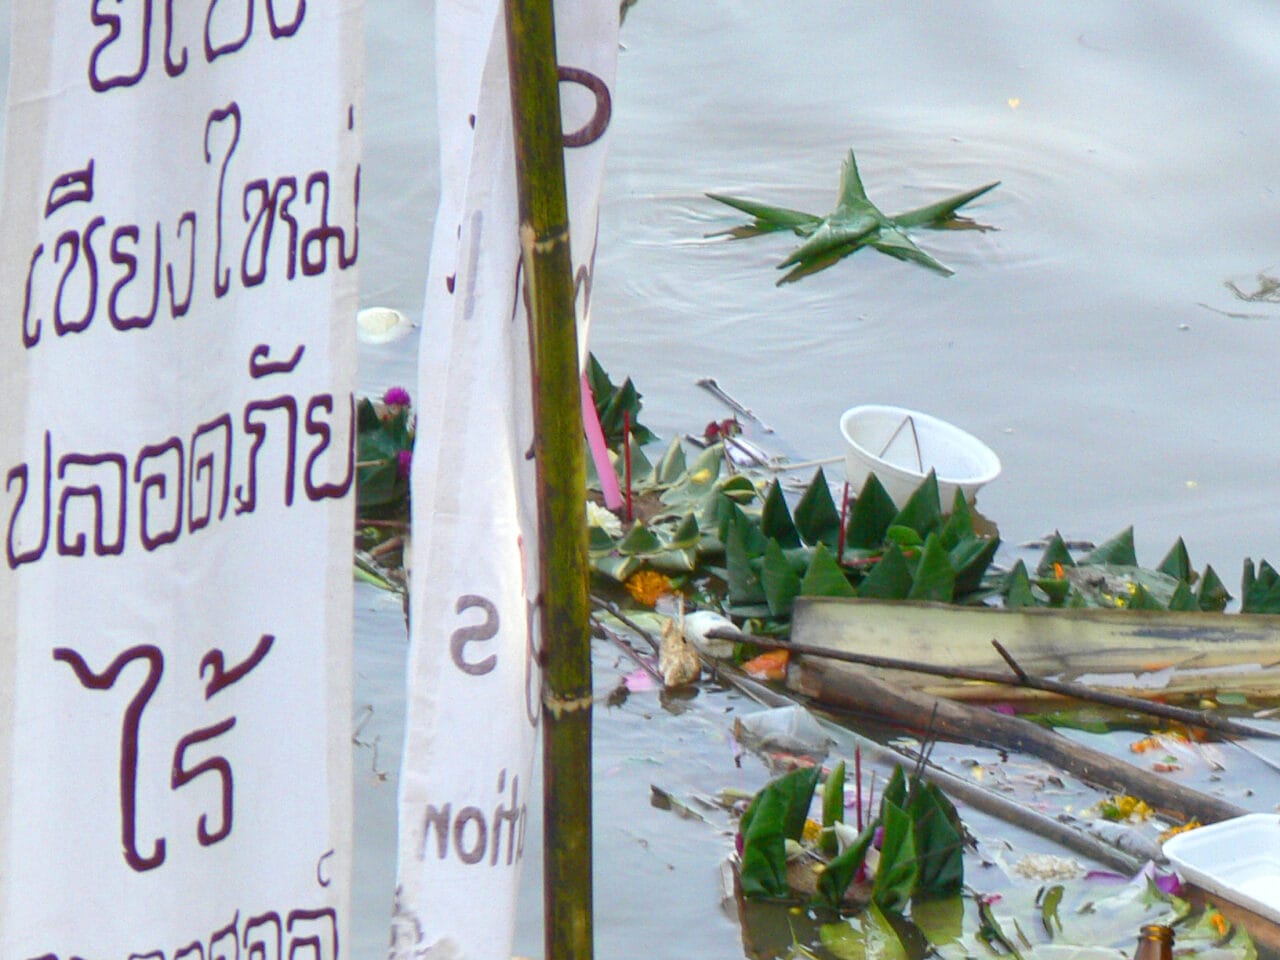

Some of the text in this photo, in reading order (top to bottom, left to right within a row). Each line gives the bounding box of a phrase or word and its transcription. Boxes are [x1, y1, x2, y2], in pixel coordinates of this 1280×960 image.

[23, 103, 359, 352] เชียงใหม่
[7, 344, 353, 569] ปลอดภัย
[54, 636, 274, 872] ไร้
